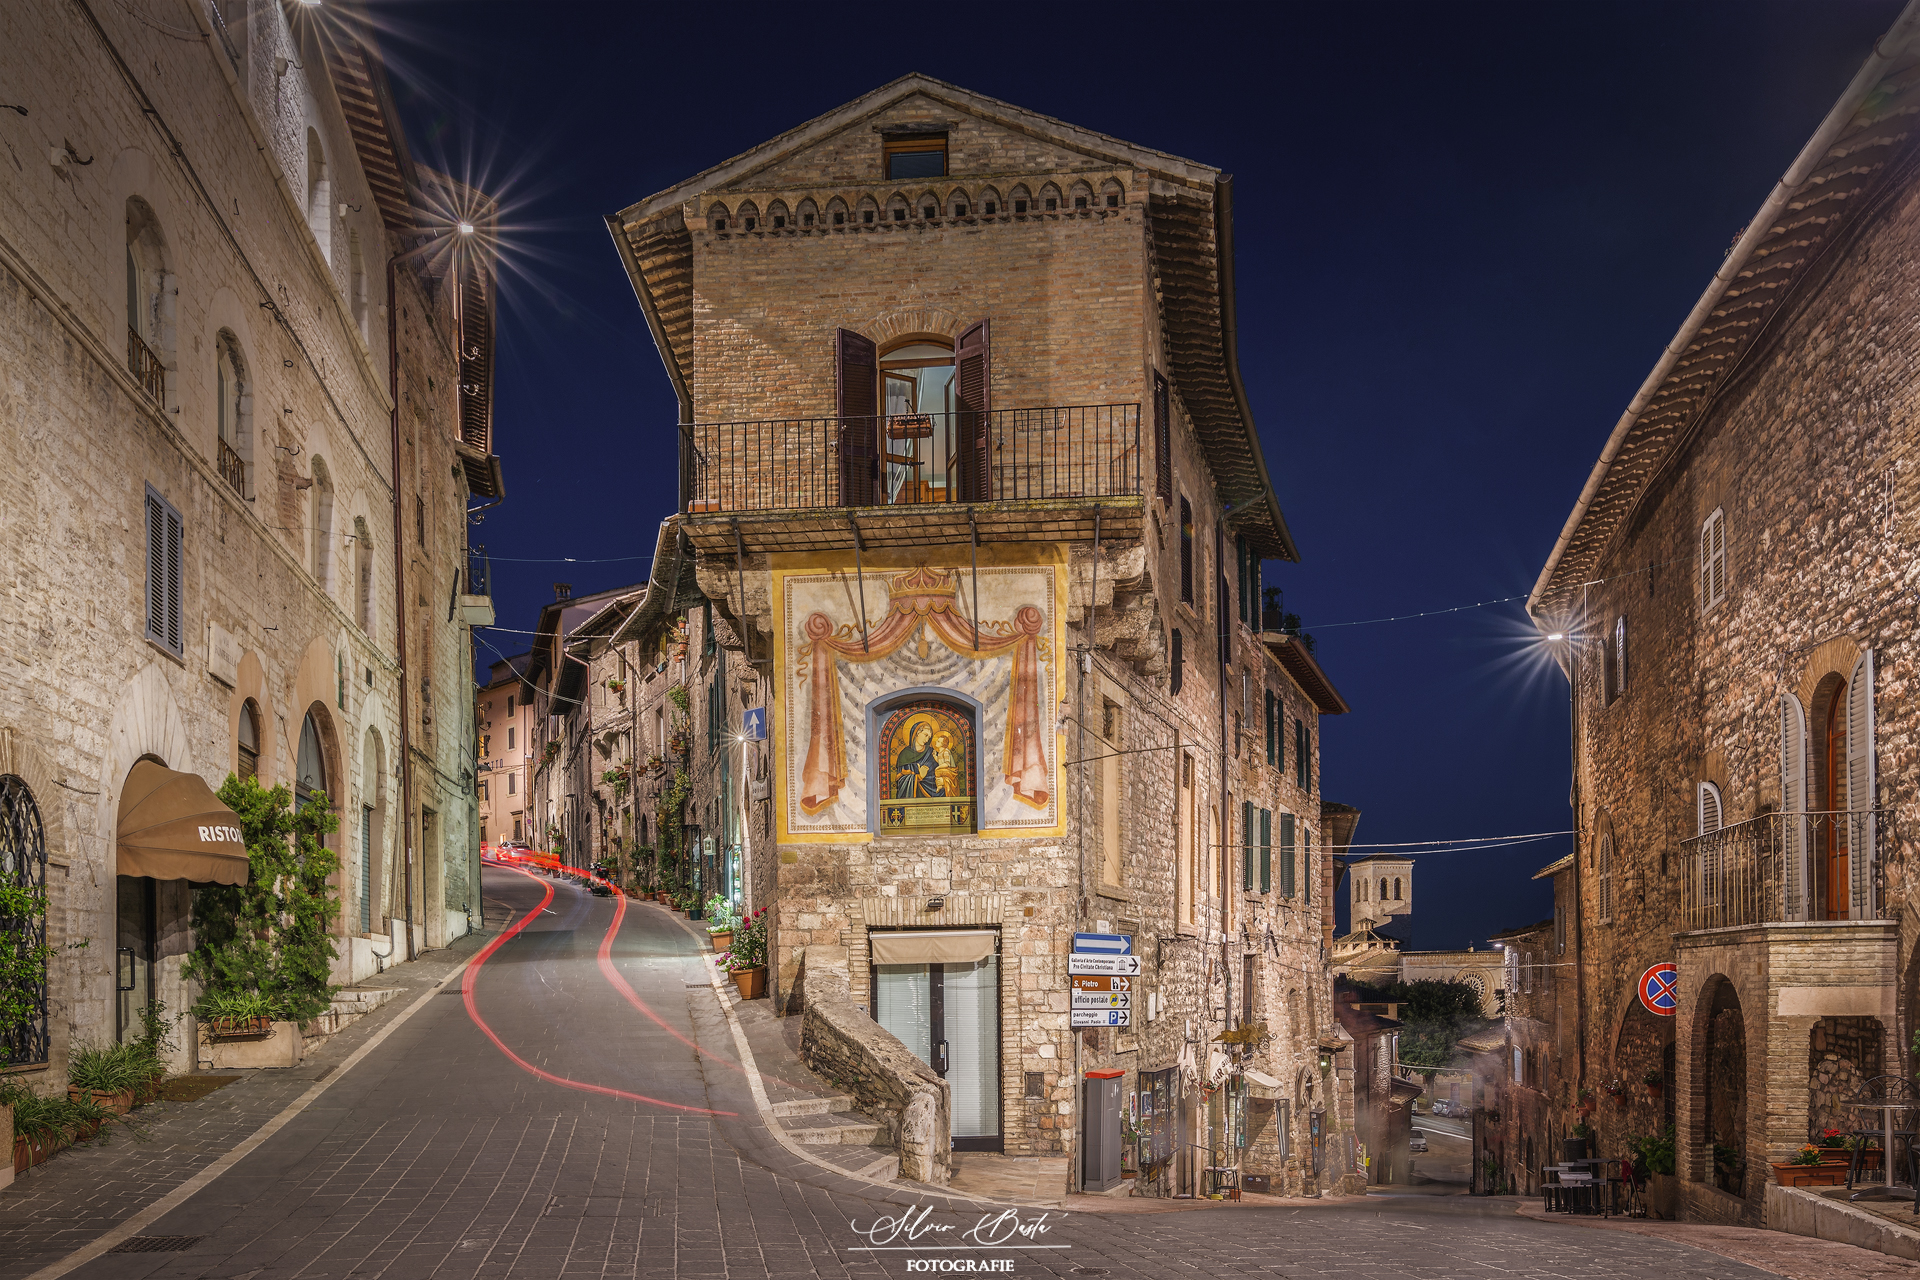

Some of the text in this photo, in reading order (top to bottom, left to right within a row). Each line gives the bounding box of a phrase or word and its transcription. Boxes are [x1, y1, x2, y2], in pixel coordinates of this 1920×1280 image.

[1081, 980, 1099, 988] Pietro
[1075, 996, 1090, 1004] ufficio
[1091, 996, 1109, 1005] postale
